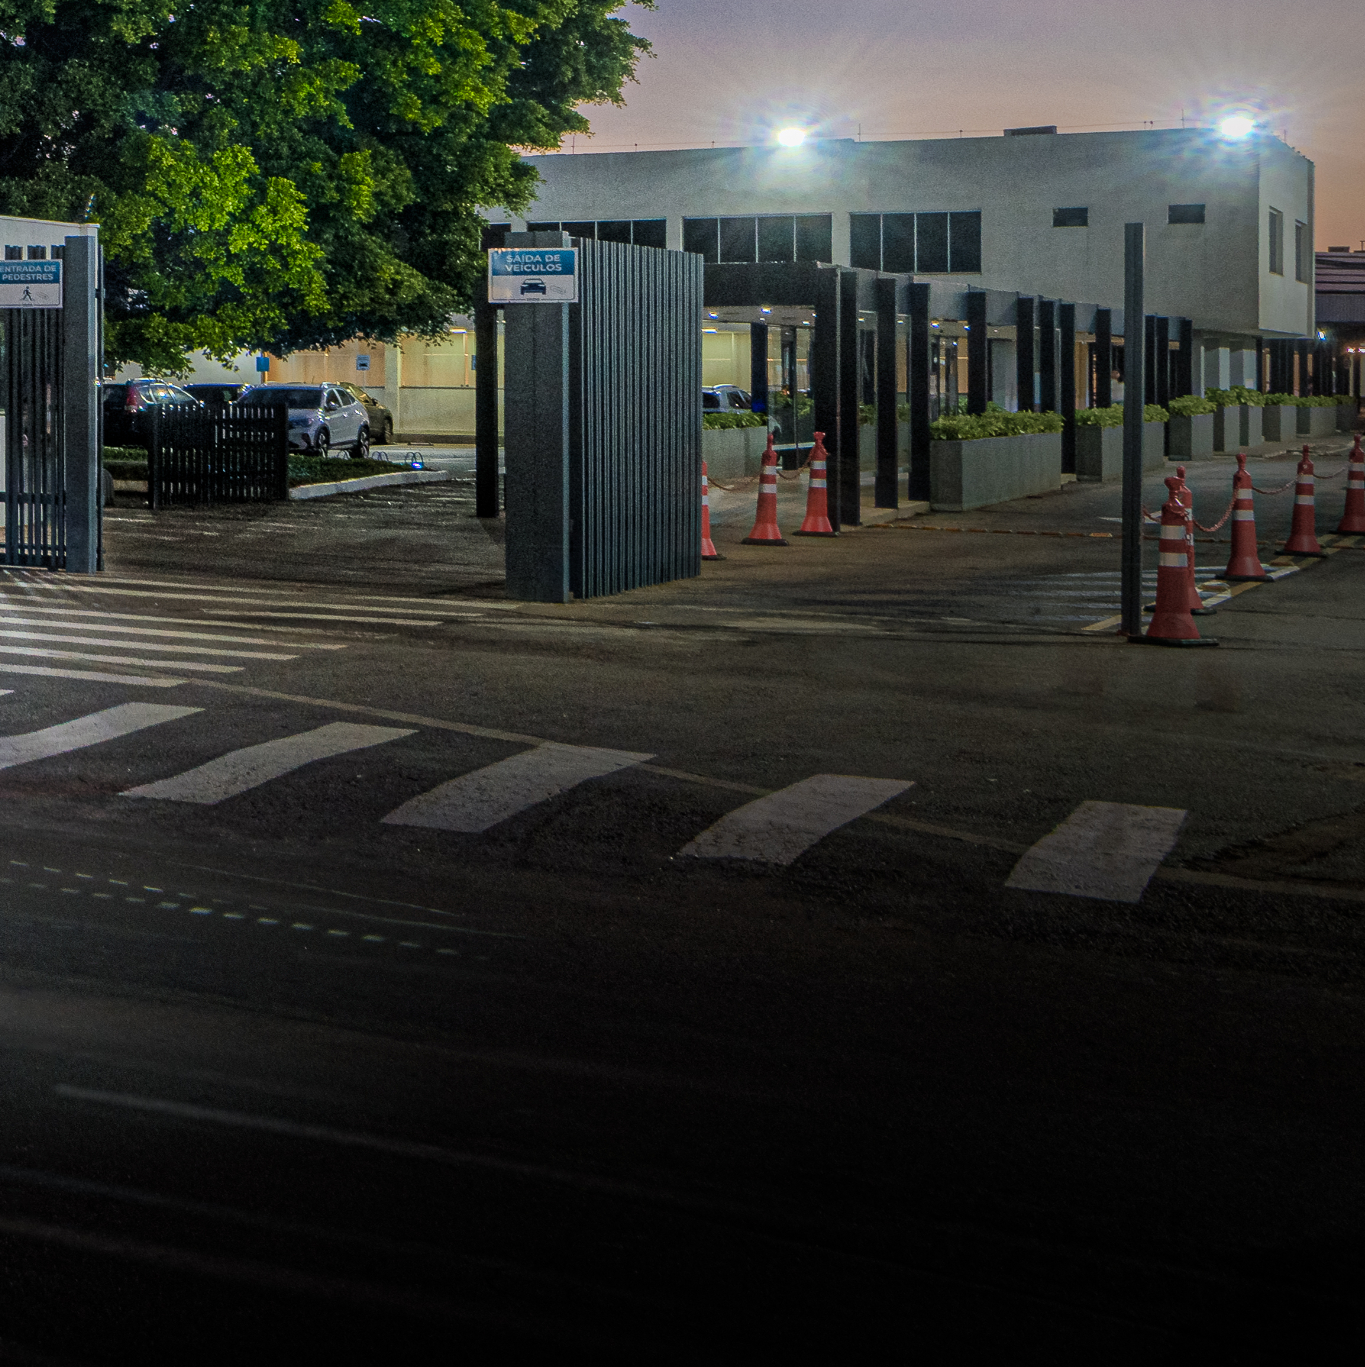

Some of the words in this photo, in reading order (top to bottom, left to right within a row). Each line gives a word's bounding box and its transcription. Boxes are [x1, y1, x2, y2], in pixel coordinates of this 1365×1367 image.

[506, 253, 542, 263] SAÍDA
[545, 254, 561, 262] DE
[44, 264, 57, 272] DE
[504, 263, 562, 272] VEÍCULOS
[2, 273, 54, 281] PEDESTRES
